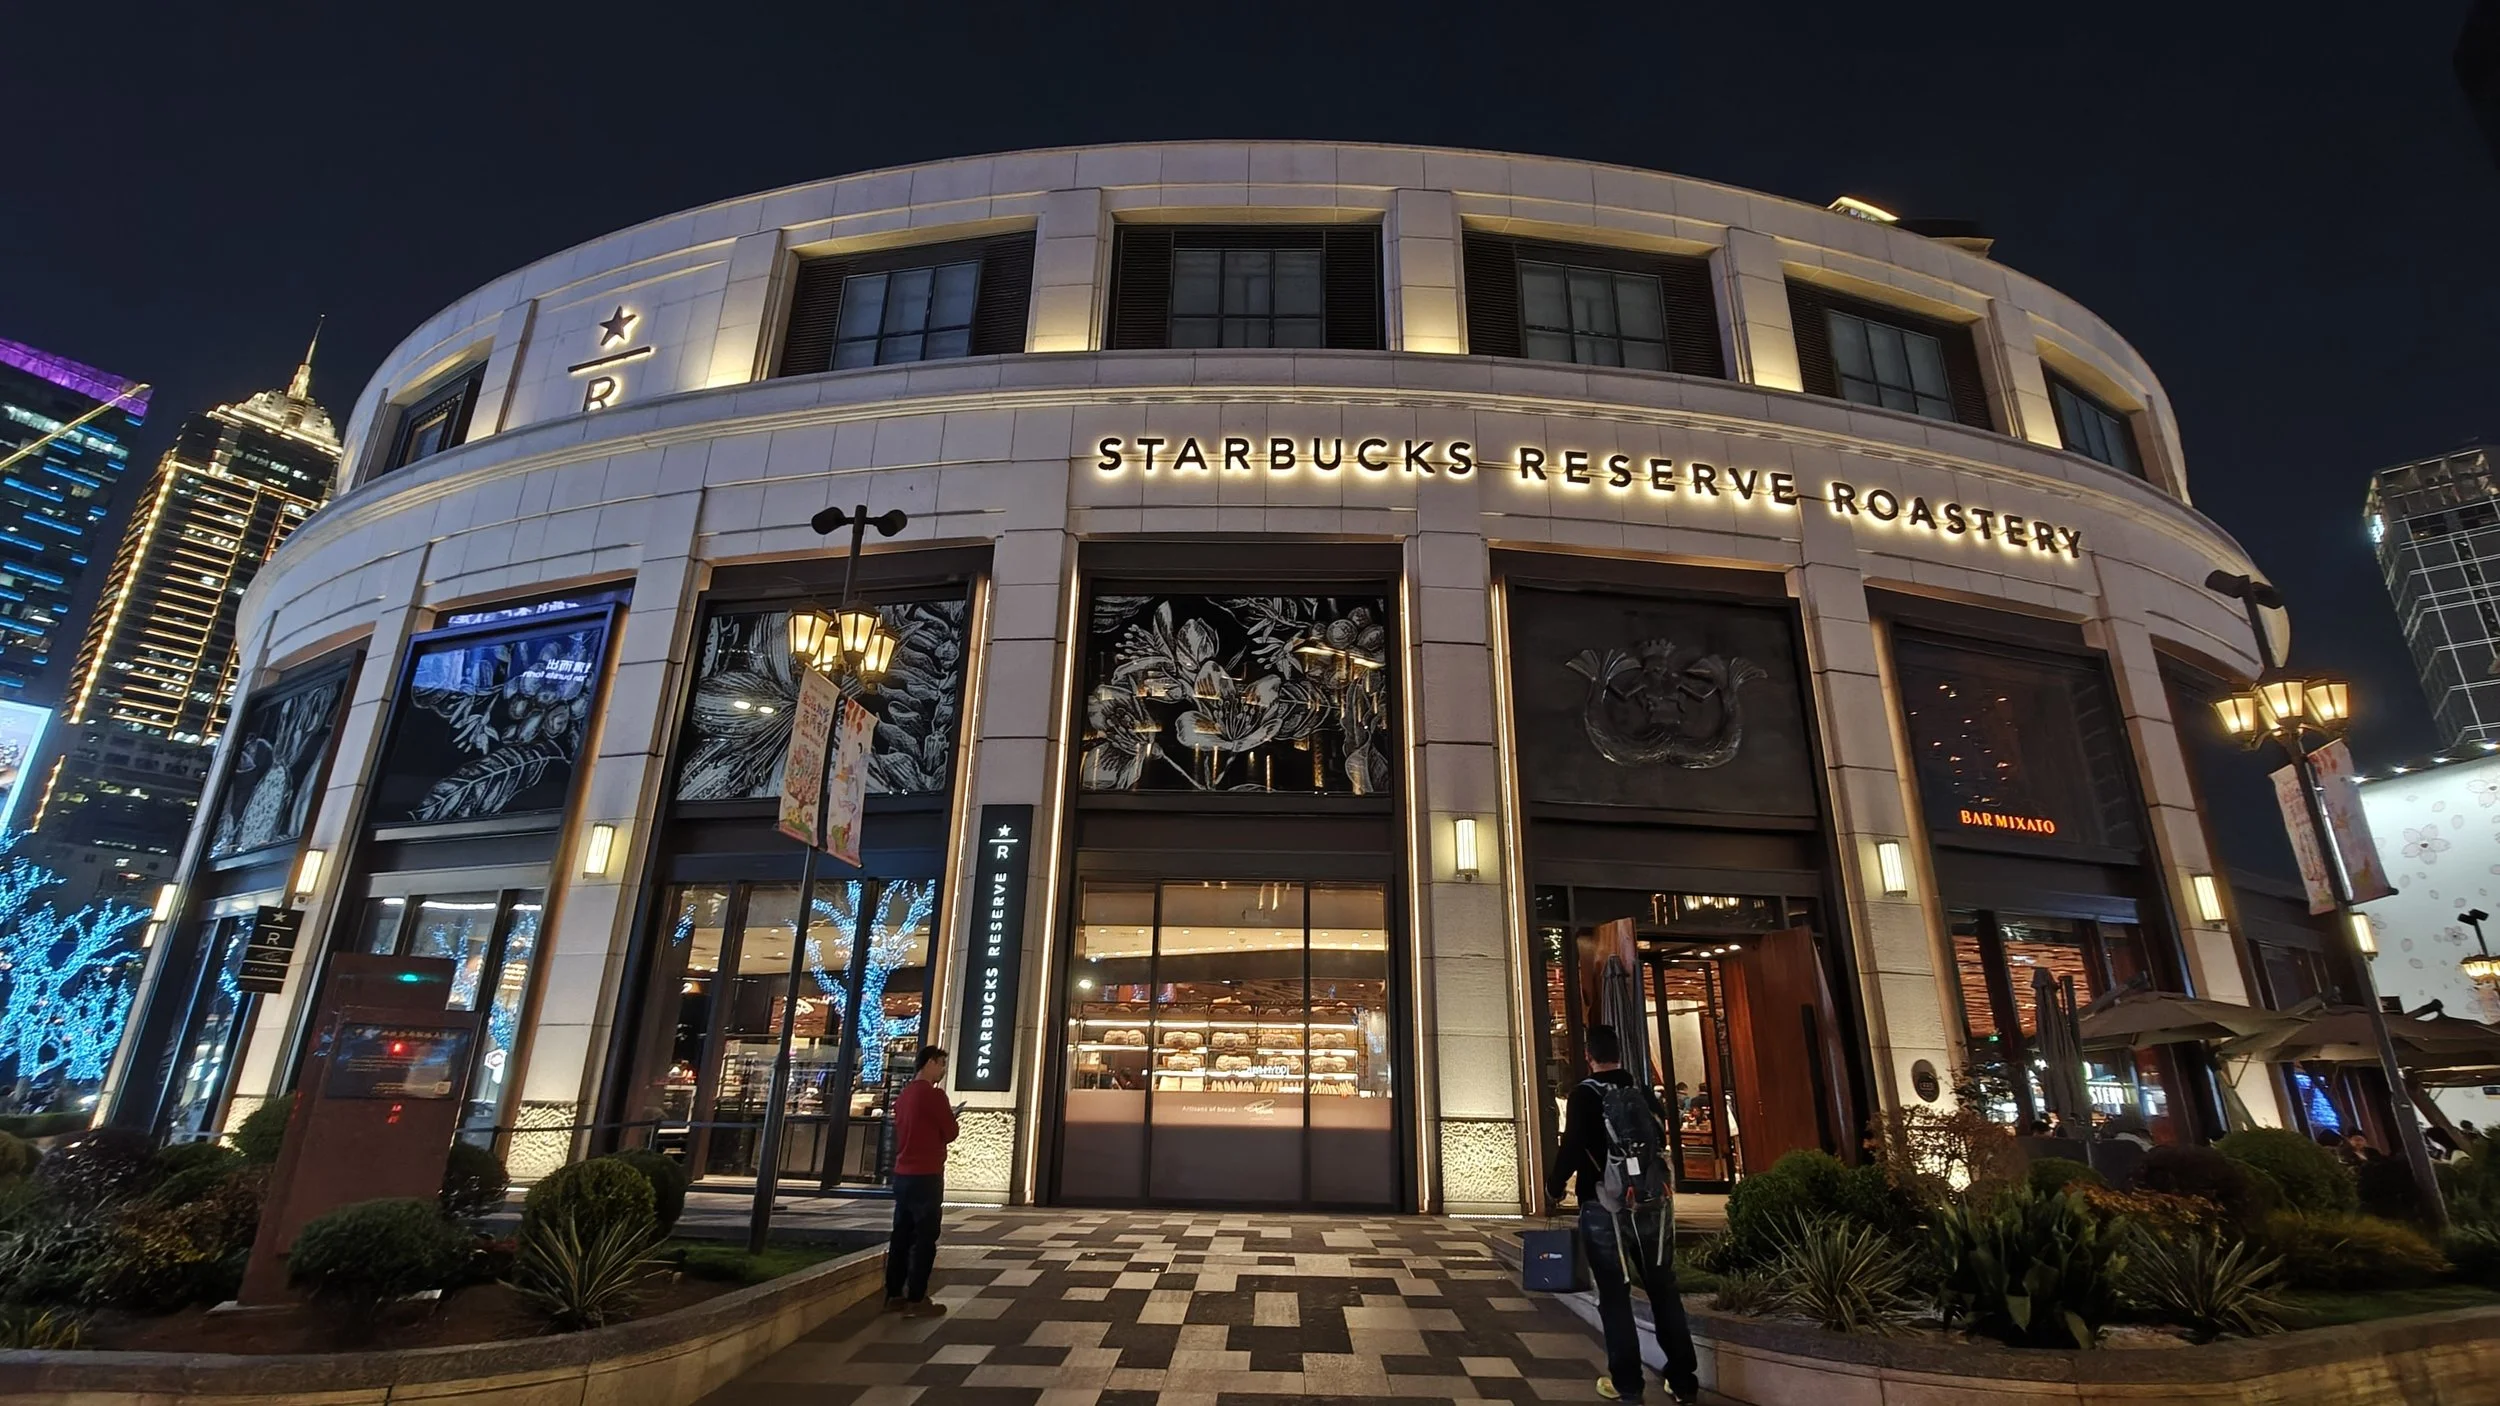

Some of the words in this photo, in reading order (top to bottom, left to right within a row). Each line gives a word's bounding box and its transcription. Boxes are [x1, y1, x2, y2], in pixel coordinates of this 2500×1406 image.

[582, 376, 616, 411] R
[1099, 437, 1472, 475] STARBUCKS
[1519, 446, 1797, 505] RESERVE
[1831, 481, 2082, 559] ROASTERY
[1961, 810, 1993, 826] BAR
[1995, 814, 2056, 834] MIXATO
[996, 845, 1009, 860] R
[266, 932, 281, 945] R
[976, 967, 998, 1079] STARBUCKS
[987, 872, 1008, 957] RESERVE
